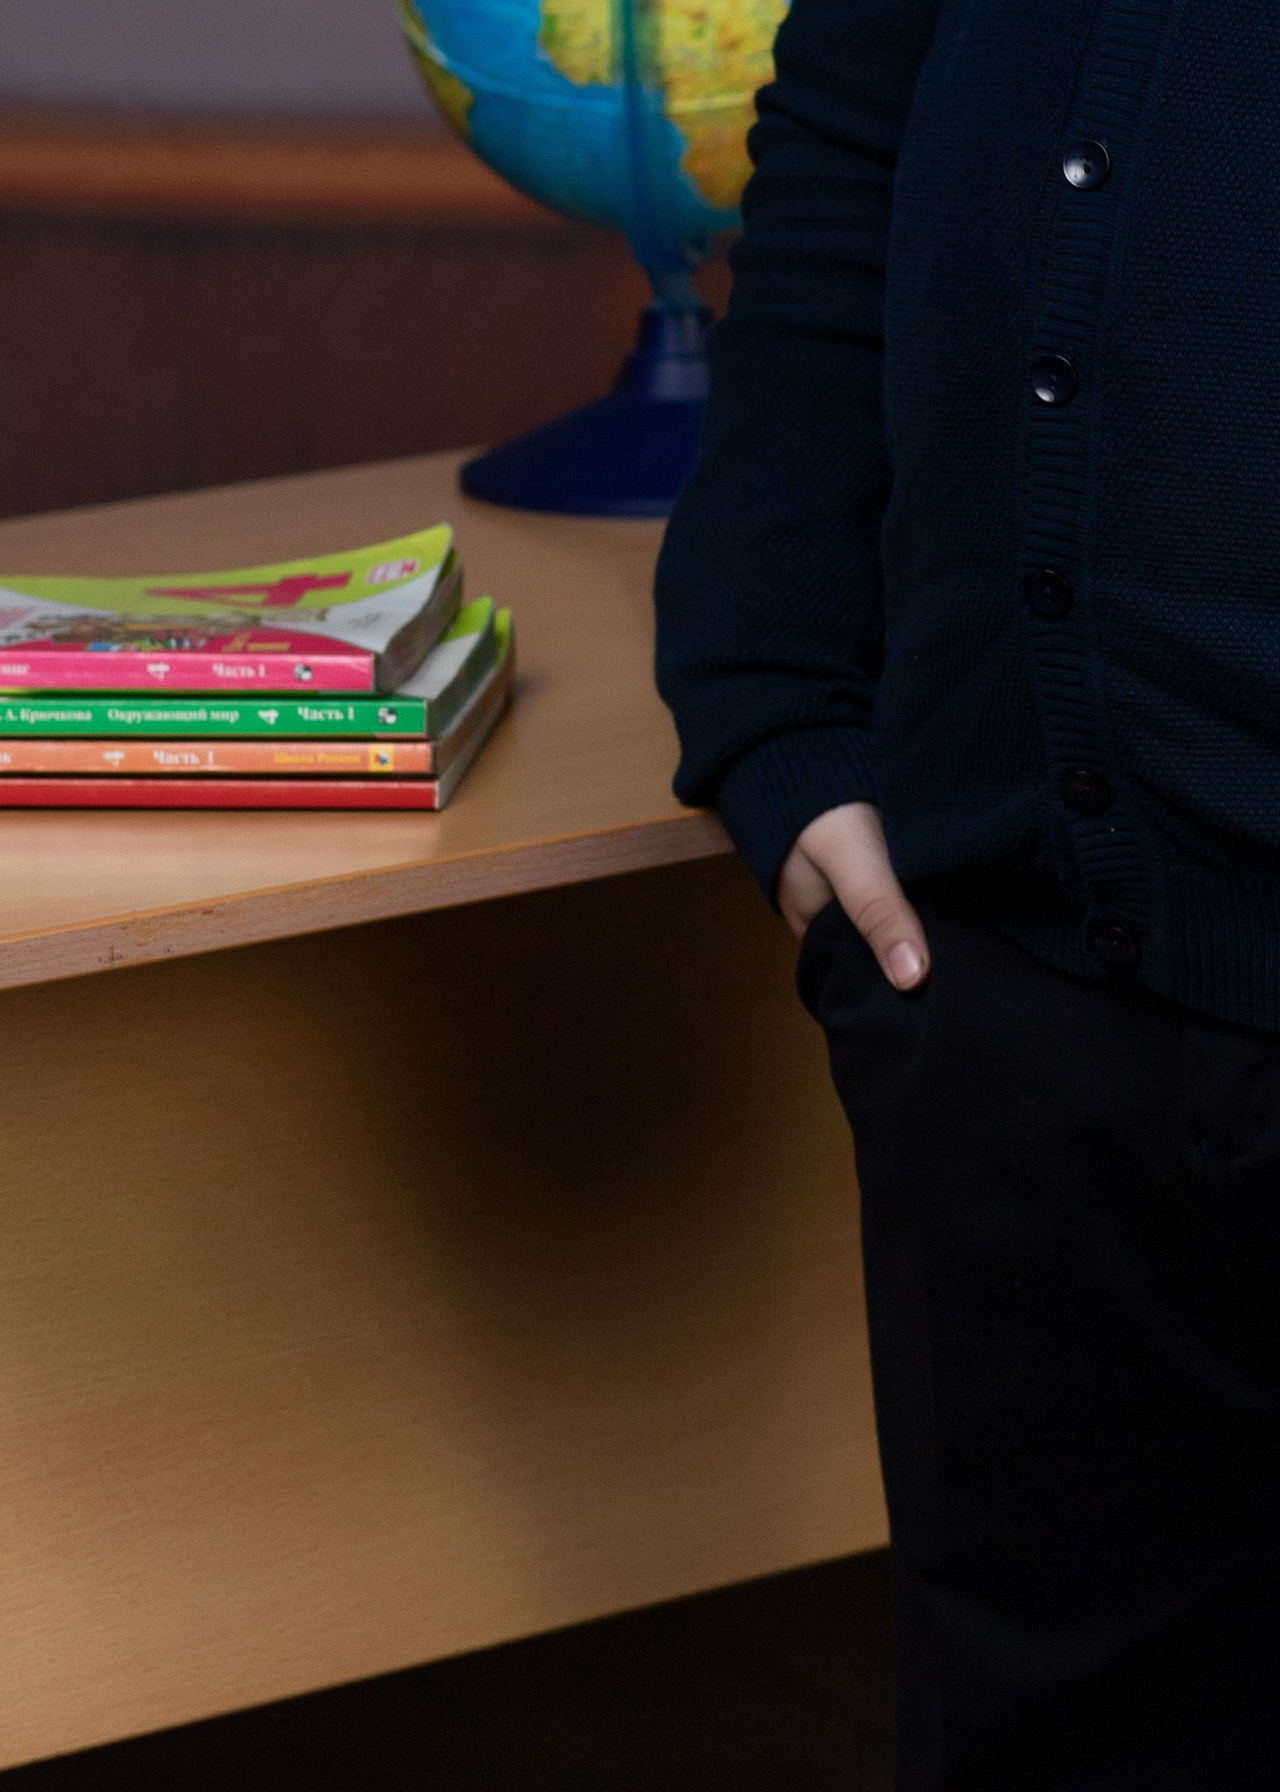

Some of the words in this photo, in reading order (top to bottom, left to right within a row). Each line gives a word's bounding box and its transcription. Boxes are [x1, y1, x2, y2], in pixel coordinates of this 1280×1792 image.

[211, 662, 256, 679] Часть
[107, 707, 207, 725] Окружающий
[209, 709, 240, 724] мир
[297, 706, 344, 722] Часть
[346, 706, 354, 721] 1
[152, 749, 200, 765] Часть
[206, 749, 214, 765] 1
